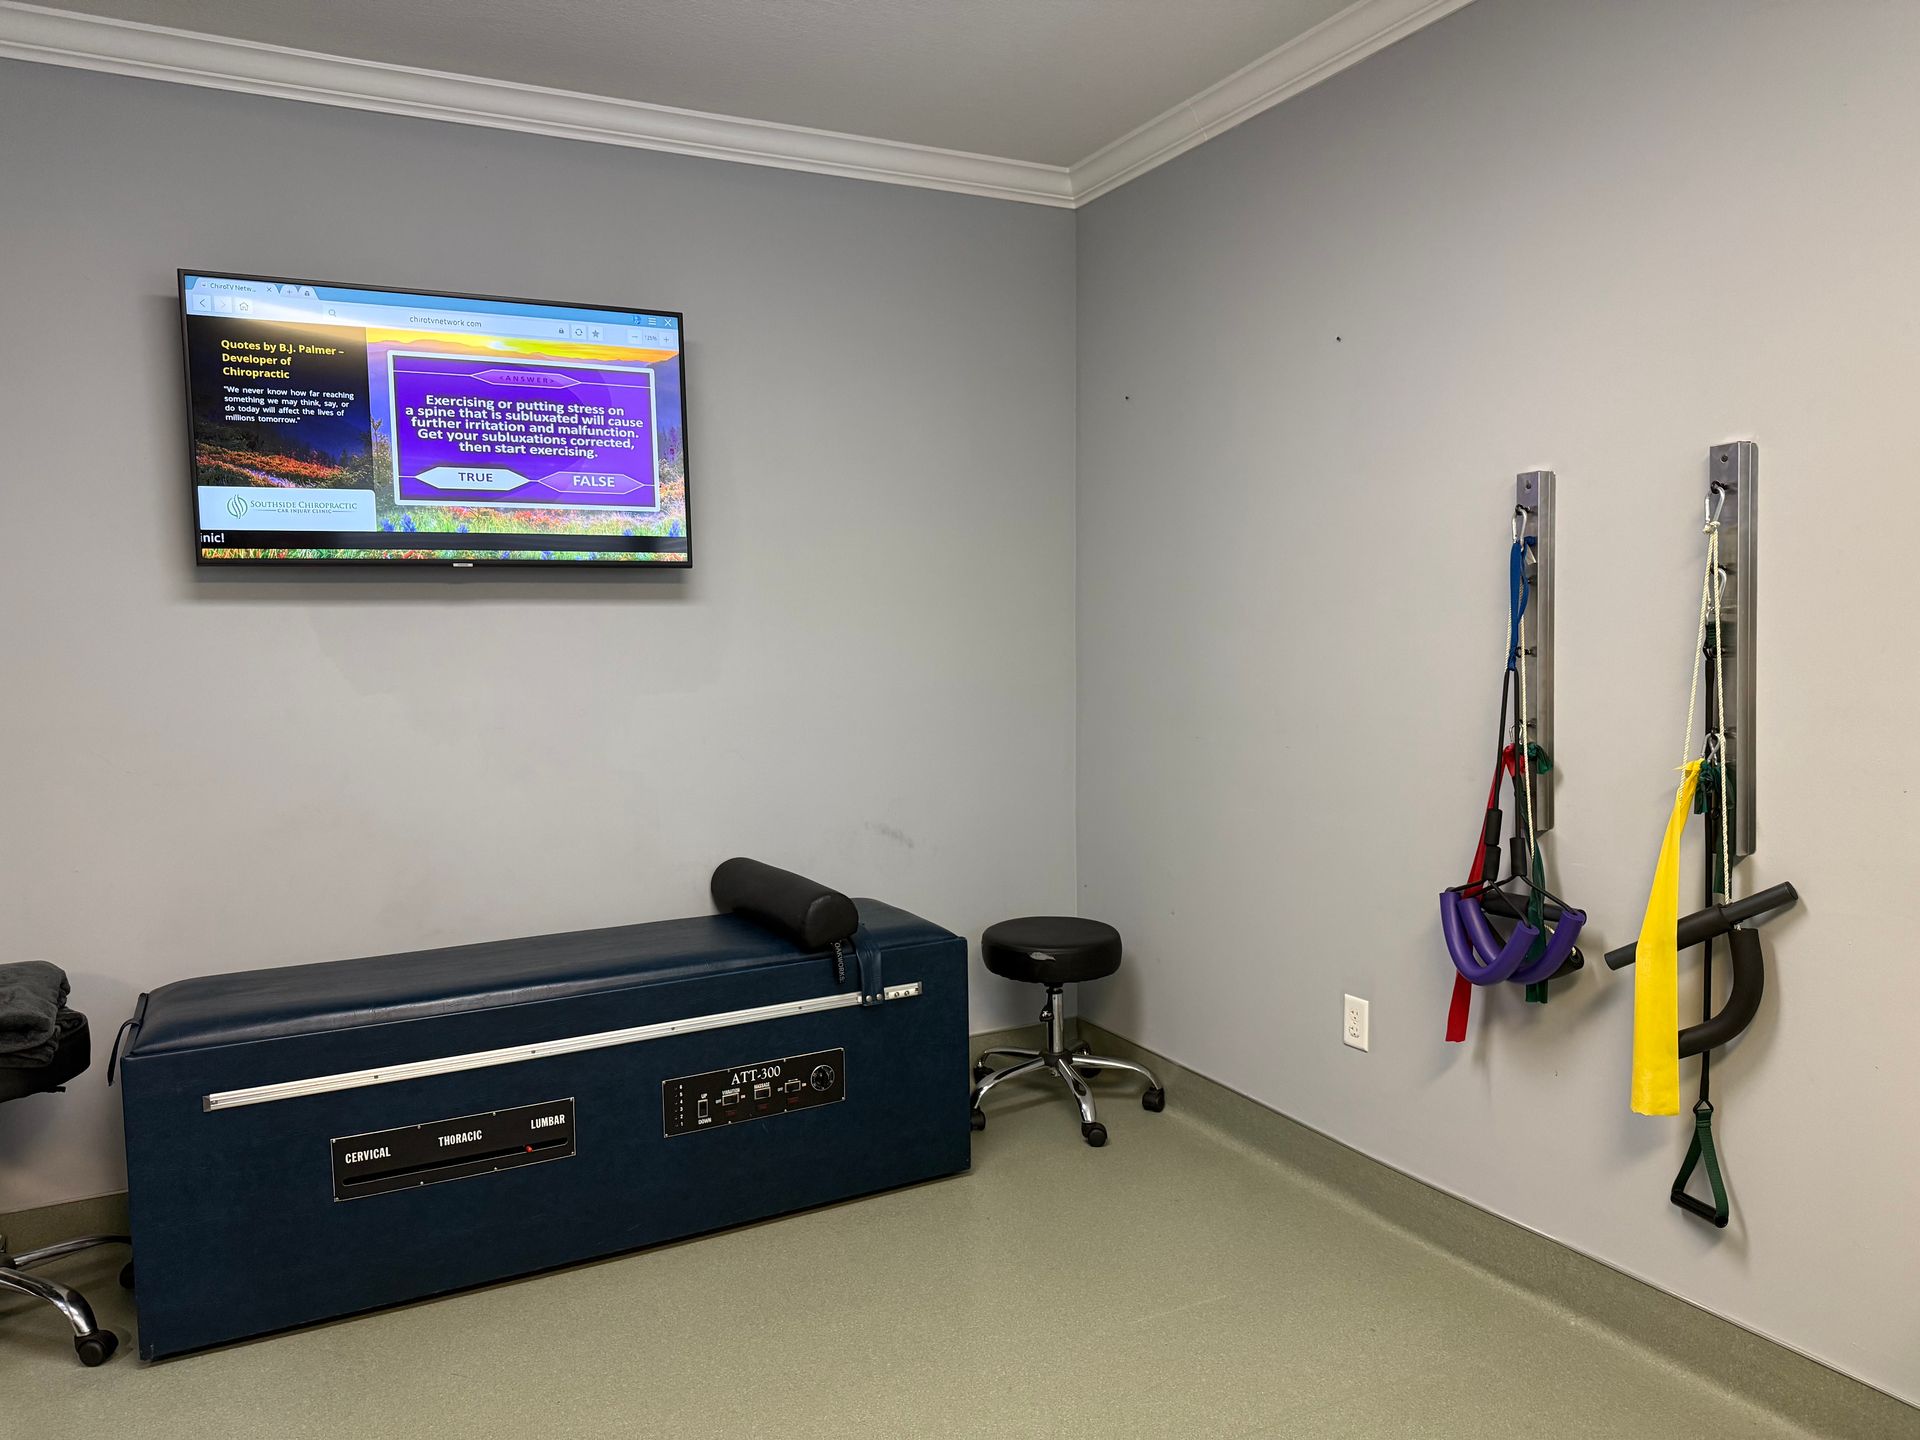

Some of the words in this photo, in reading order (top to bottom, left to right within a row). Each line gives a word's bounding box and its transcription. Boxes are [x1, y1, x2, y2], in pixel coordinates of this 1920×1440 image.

[221, 340, 260, 350] Quotes
[263, 342, 276, 353] by
[280, 343, 296, 354] B.J.
[298, 344, 336, 356] Palmer
[222, 353, 278, 366] Developer
[280, 356, 292, 366] of
[222, 366, 290, 379] Chiropractic
[224, 396, 264, 406] something
[282, 398, 298, 406] may
[300, 398, 321, 408] think,
[324, 400, 338, 408] say,
[266, 388, 288, 396] know
[290, 388, 306, 397] how
[309, 390, 320, 398] far
[322, 391, 354, 400] reaching
[238, 405, 260, 414] today
[278, 406, 300, 415] affect
[302, 408, 314, 416] the
[318, 408, 334, 416] lives
[426, 394, 494, 410] Exercising
[498, 400, 512, 409] or
[516, 402, 564, 414] putting
[568, 404, 604, 414] stress
[608, 408, 624, 416] on
[225, 414, 256, 422] millions
[406, 407, 414, 416] a
[418, 406, 455, 418] spine
[459, 408, 488, 420] that
[492, 409, 502, 420] is
[506, 410, 578, 424] subluxated
[582, 414, 604, 426] will
[608, 418, 644, 428] cause
[411, 416, 462, 429] further
[466, 420, 525, 432] irritation
[530, 424, 554, 434] and
[558, 425, 639, 438] malfunction.
[418, 428, 443, 440] Get
[446, 432, 478, 442] your
[482, 432, 567, 445] subluxations
[570, 438, 634, 450] corrected,
[459, 442, 491, 452] then
[494, 444, 526, 454] start
[530, 445, 598, 459] exercising.
[458, 472, 494, 482] TRUE
[572, 475, 615, 488] FALSE
[250, 500, 296, 508] SOUTHSIDE
[298, 501, 358, 510] CHIROPRACTIC
[731, 1066, 781, 1086] ATT-300
[530, 1114, 566, 1130] LUMBAR
[438, 1130, 482, 1147] THORACIC
[345, 1146, 391, 1164] CERVICAL
